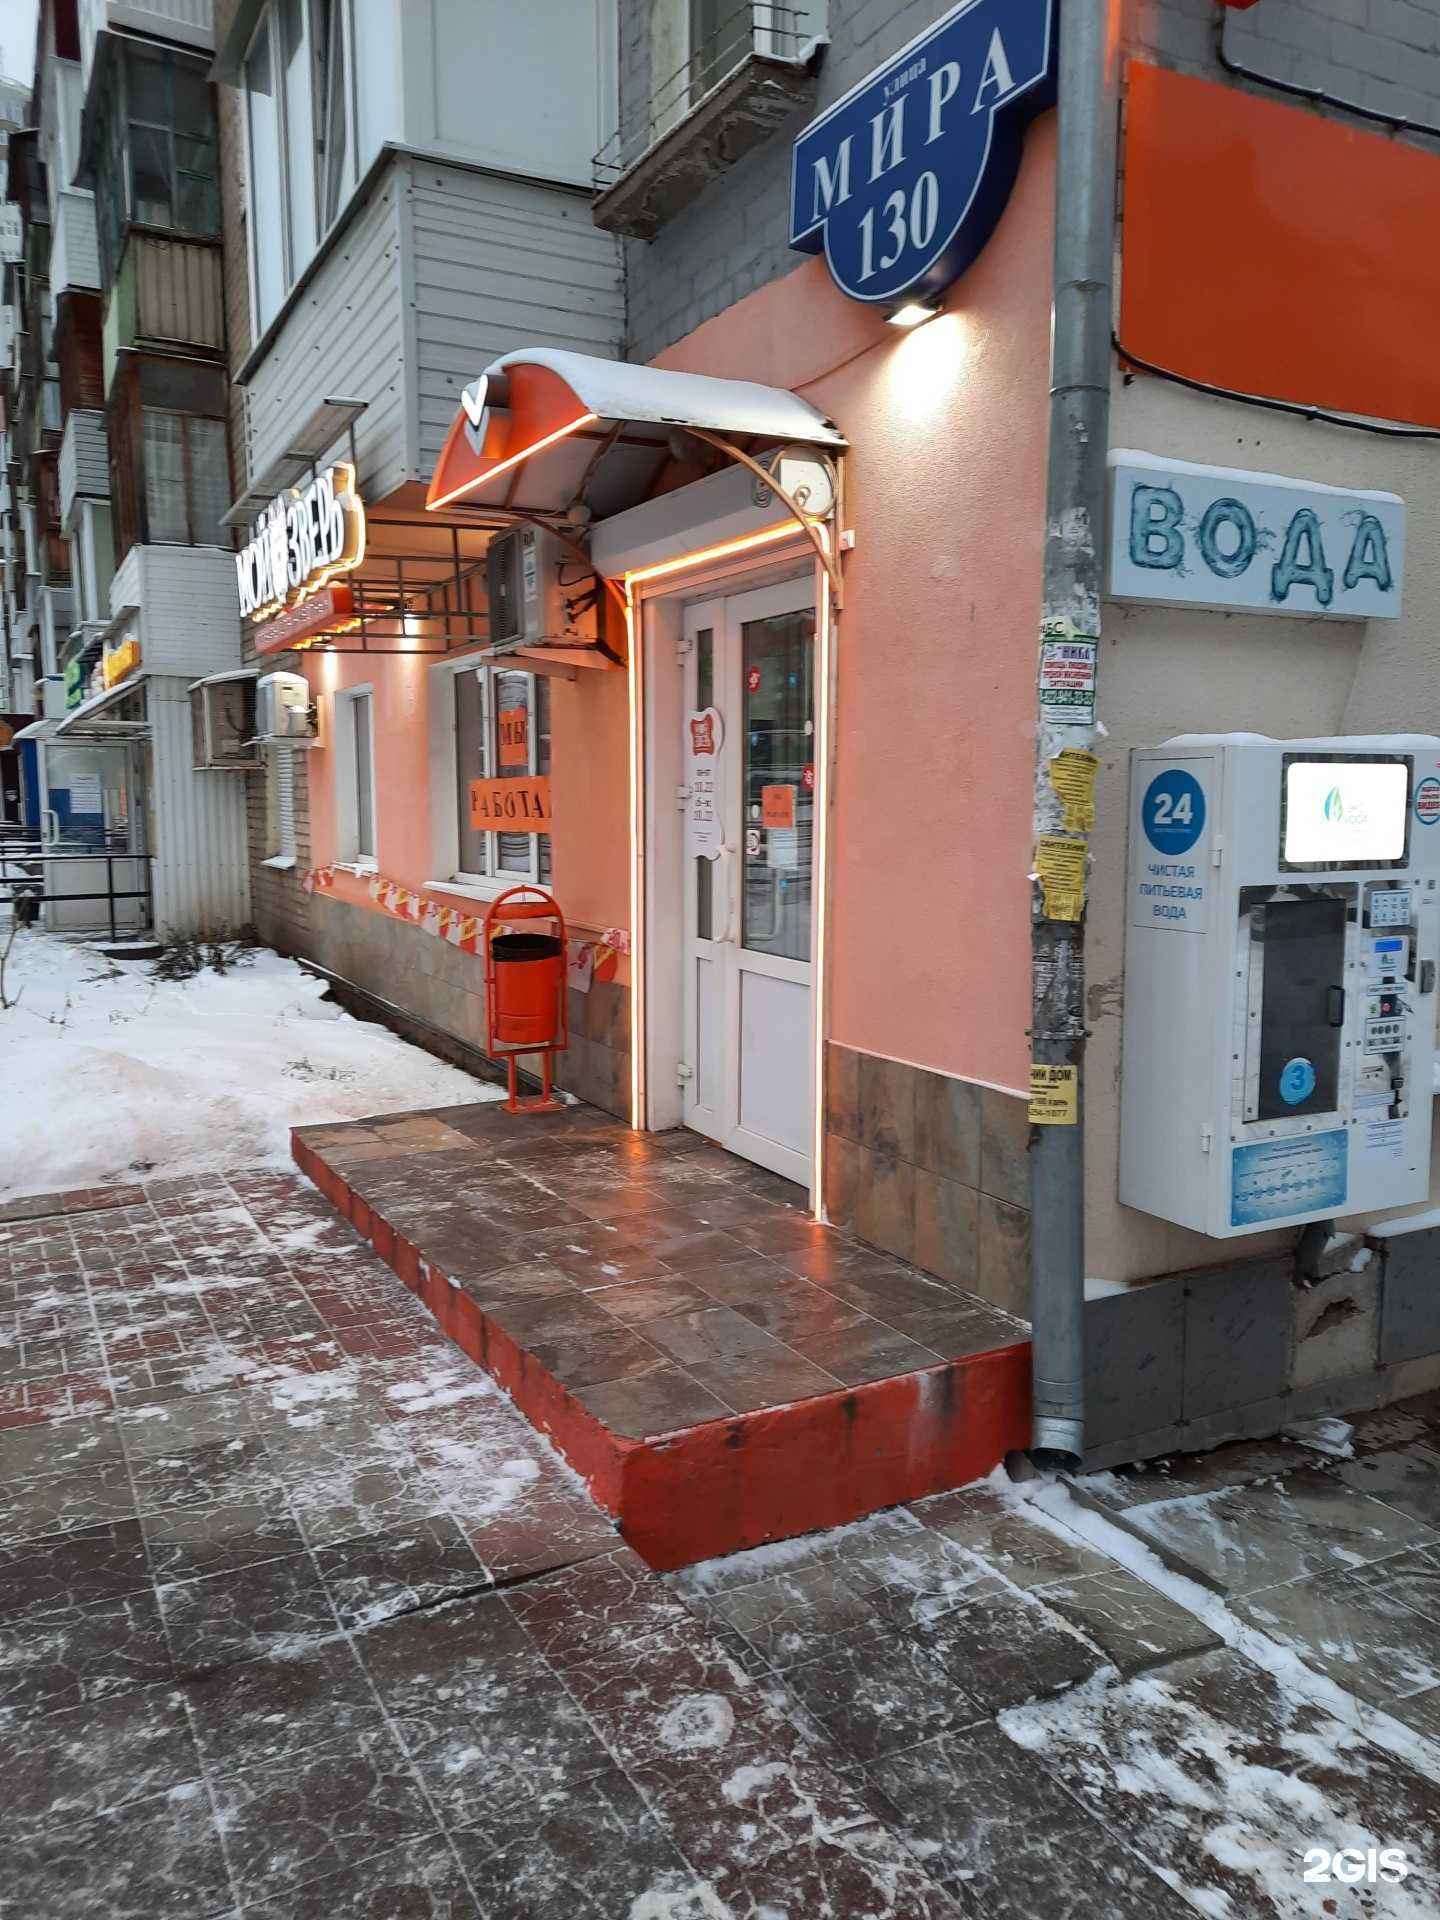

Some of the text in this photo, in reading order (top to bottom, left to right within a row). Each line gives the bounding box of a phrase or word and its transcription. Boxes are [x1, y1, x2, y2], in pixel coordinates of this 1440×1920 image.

[883, 57, 927, 106] улица
[811, 26, 1016, 223] МИРА
[856, 170, 939, 284] 130
[1129, 484, 1392, 605] ВОДА
[500, 720, 528, 746] МЫ
[1154, 793, 1193, 825] 24
[1149, 864, 1195, 878] ЧИСТАЯ
[1139, 883, 1203, 900] ПИТЬЕВАЯ
[1152, 904, 1187, 920] ВОДА
[1290, 1065, 1305, 1091] 3
